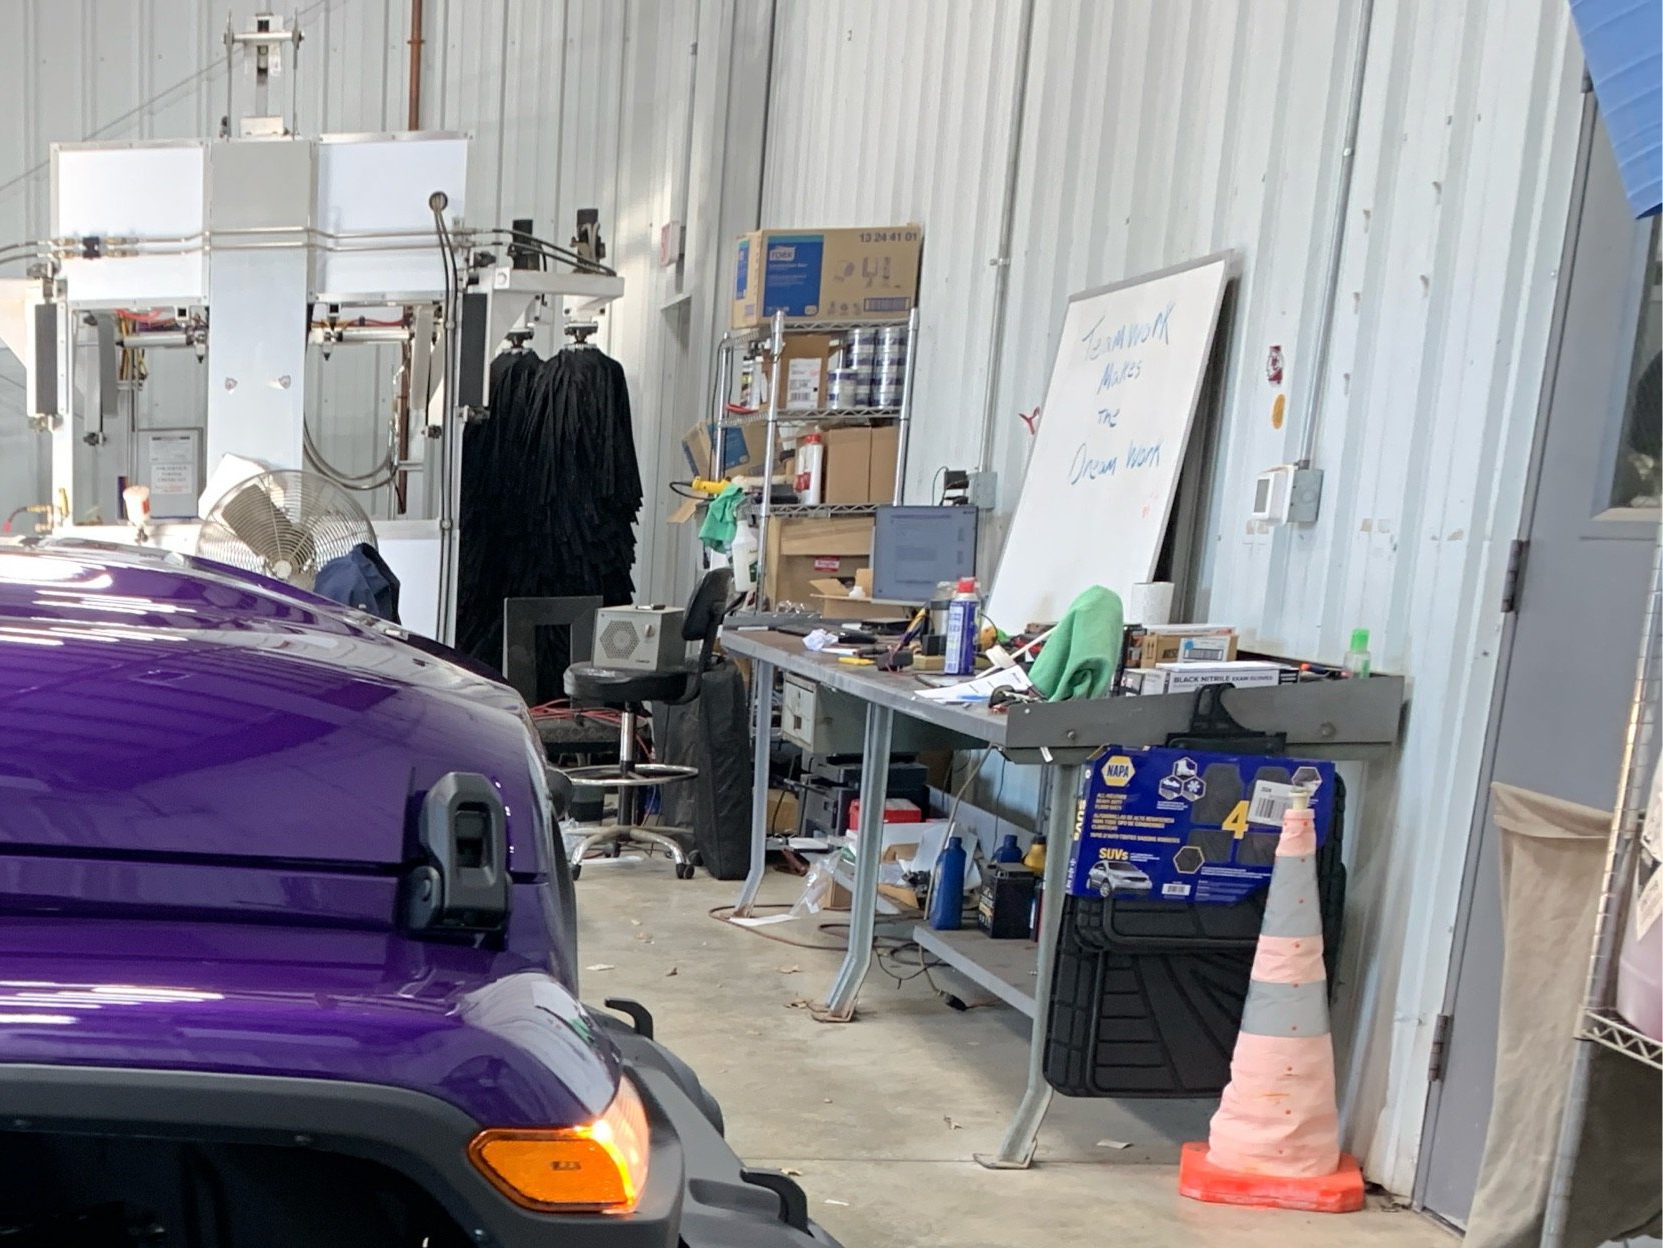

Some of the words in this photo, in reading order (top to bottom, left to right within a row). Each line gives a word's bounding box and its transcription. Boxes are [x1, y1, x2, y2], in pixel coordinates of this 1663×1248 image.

[860, 232, 872, 243] 13
[874, 232, 887, 243] 24
[889, 231, 902, 242] 41
[904, 231, 918, 242] 01
[1201, 675, 1230, 683] NITRILE
[1106, 764, 1129, 778] NAPA
[1222, 800, 1250, 840] 4
[1098, 847, 1129, 861] SUVs
